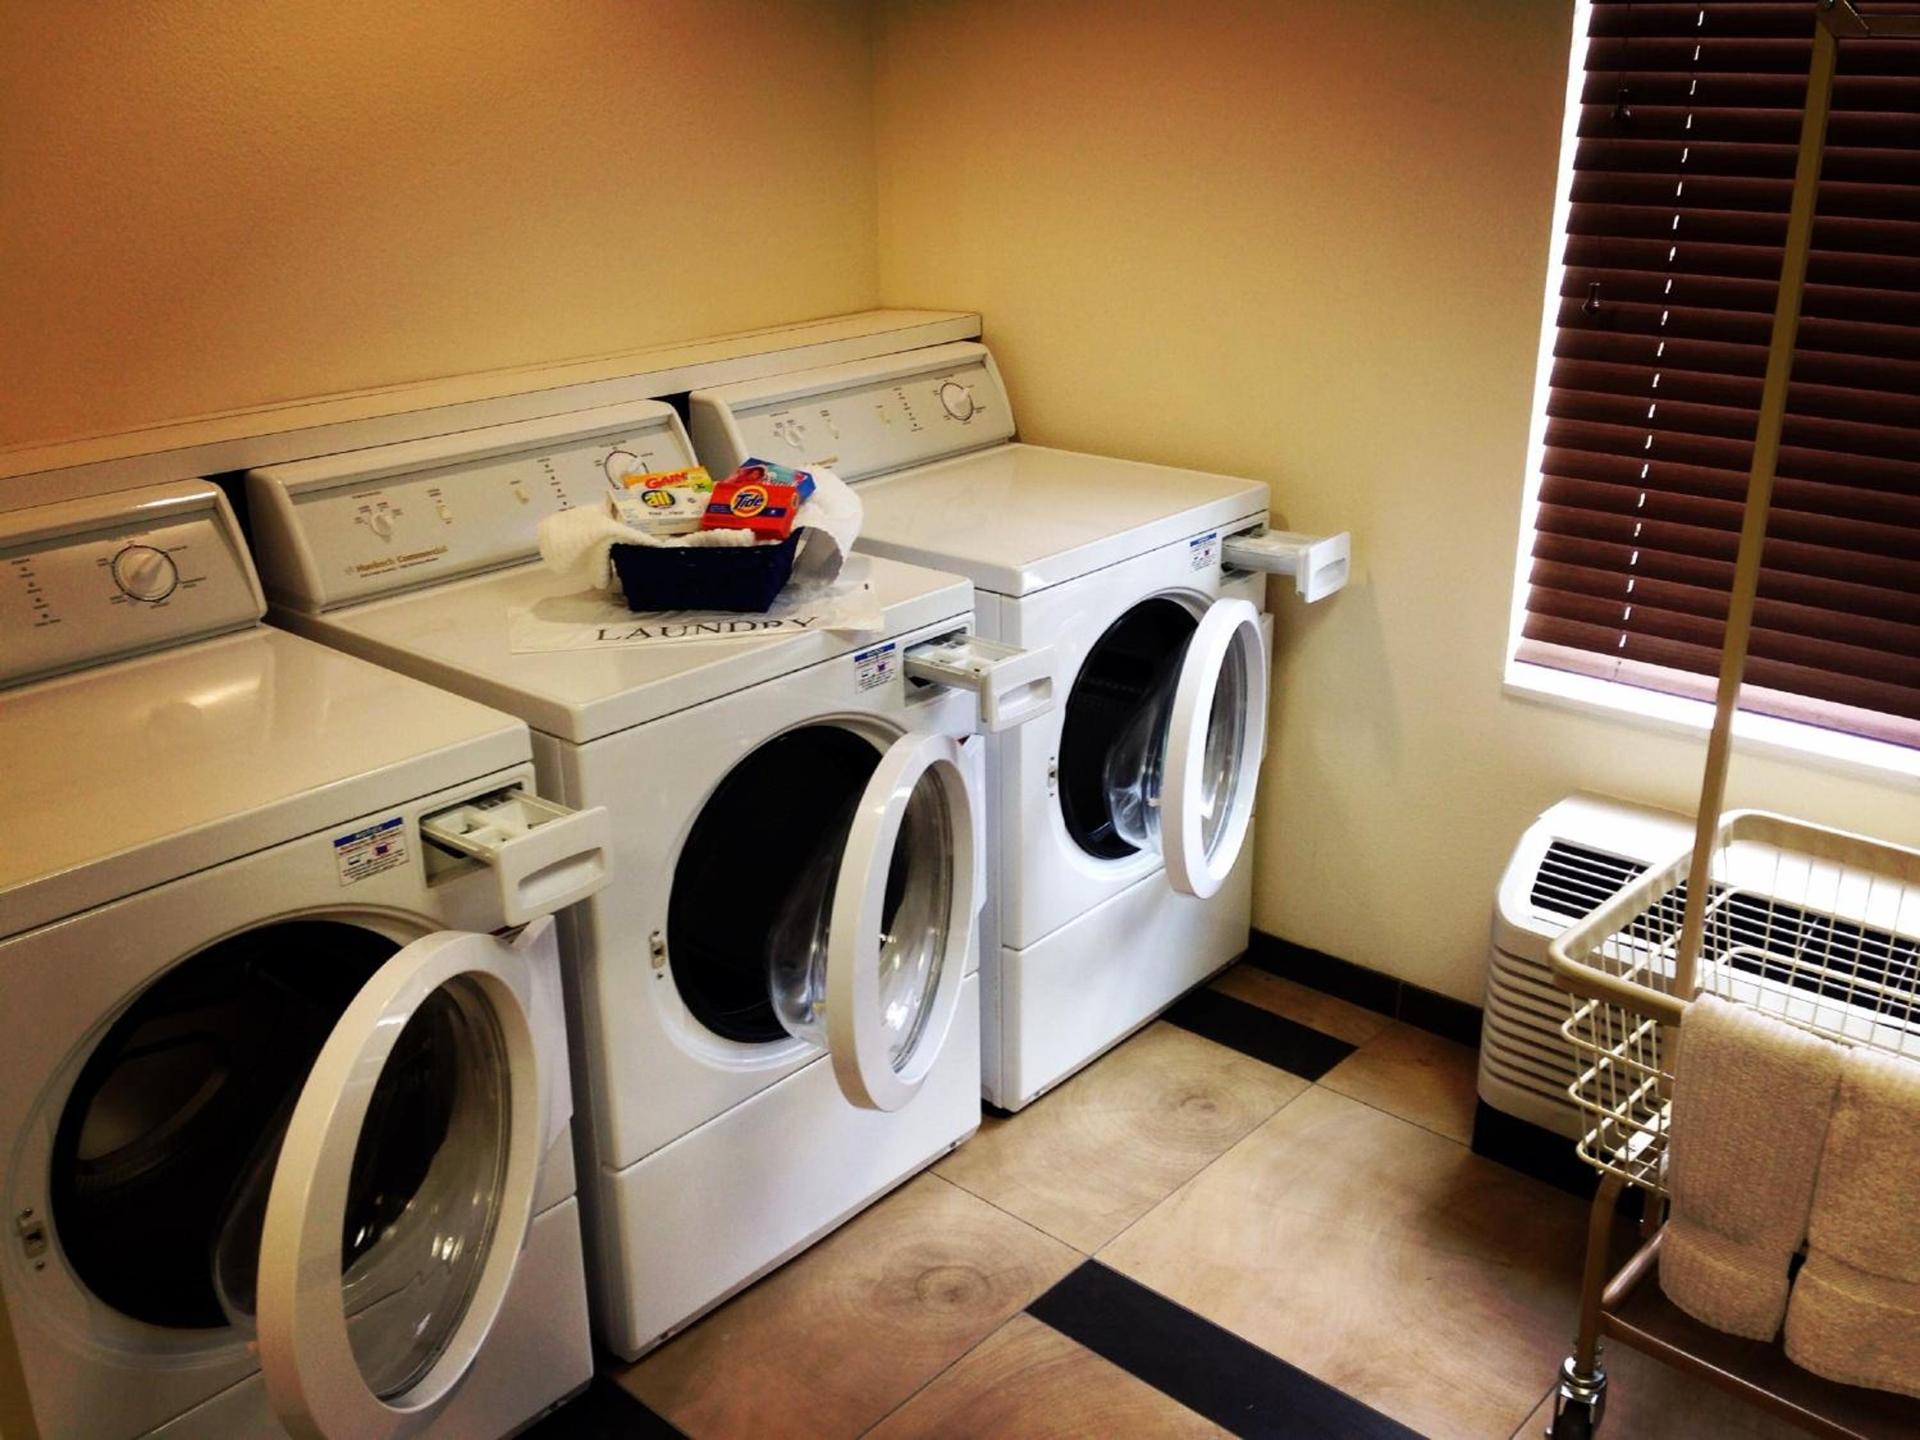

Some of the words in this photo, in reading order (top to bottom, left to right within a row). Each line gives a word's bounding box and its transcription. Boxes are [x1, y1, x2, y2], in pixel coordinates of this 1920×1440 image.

[645, 490, 671, 507] all
[732, 491, 765, 510] Tide
[597, 617, 818, 640] LAUNDRY
